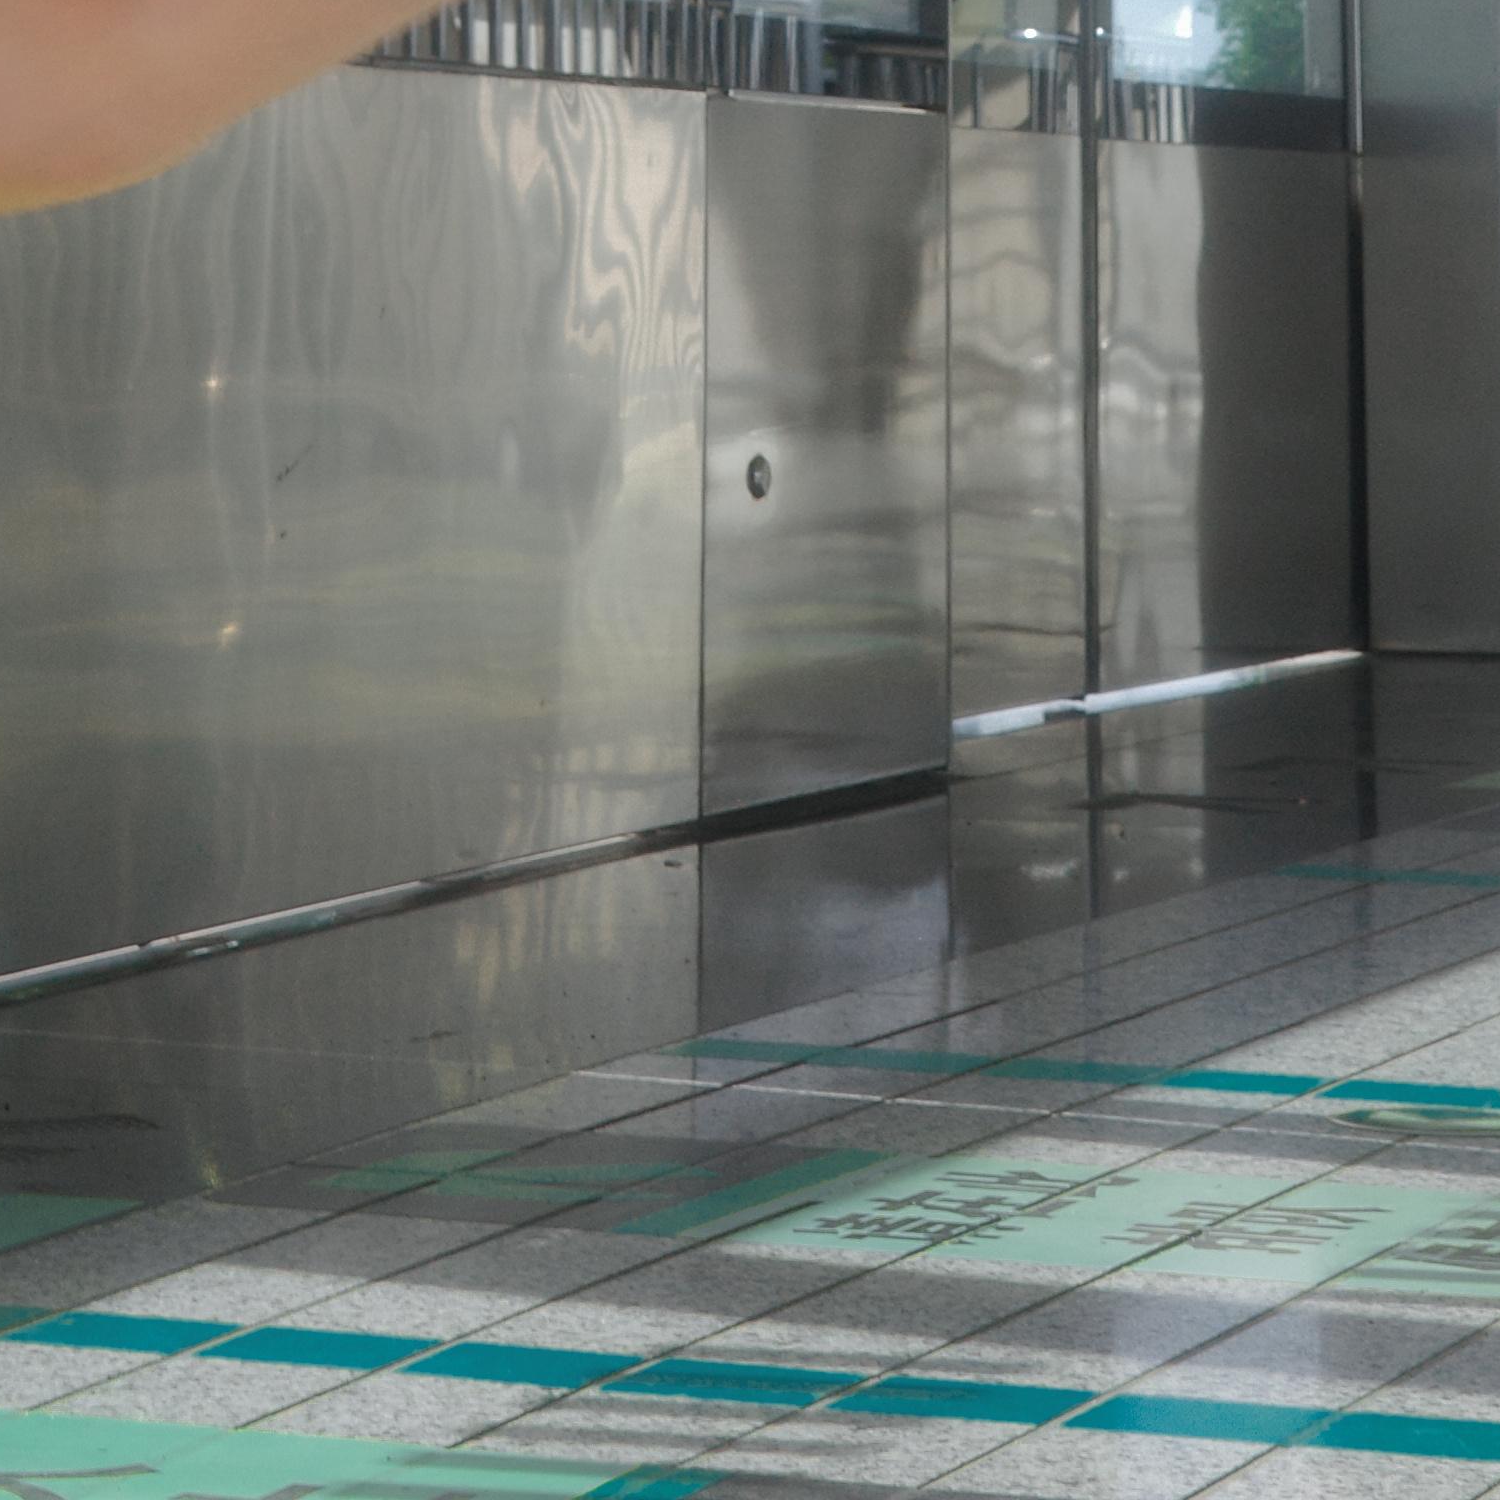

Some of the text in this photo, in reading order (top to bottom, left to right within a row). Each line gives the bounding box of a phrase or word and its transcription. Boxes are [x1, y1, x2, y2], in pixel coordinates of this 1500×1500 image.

[792, 1170, 1140, 1246] 请在此
[1102, 1201, 1393, 1254] 排队
